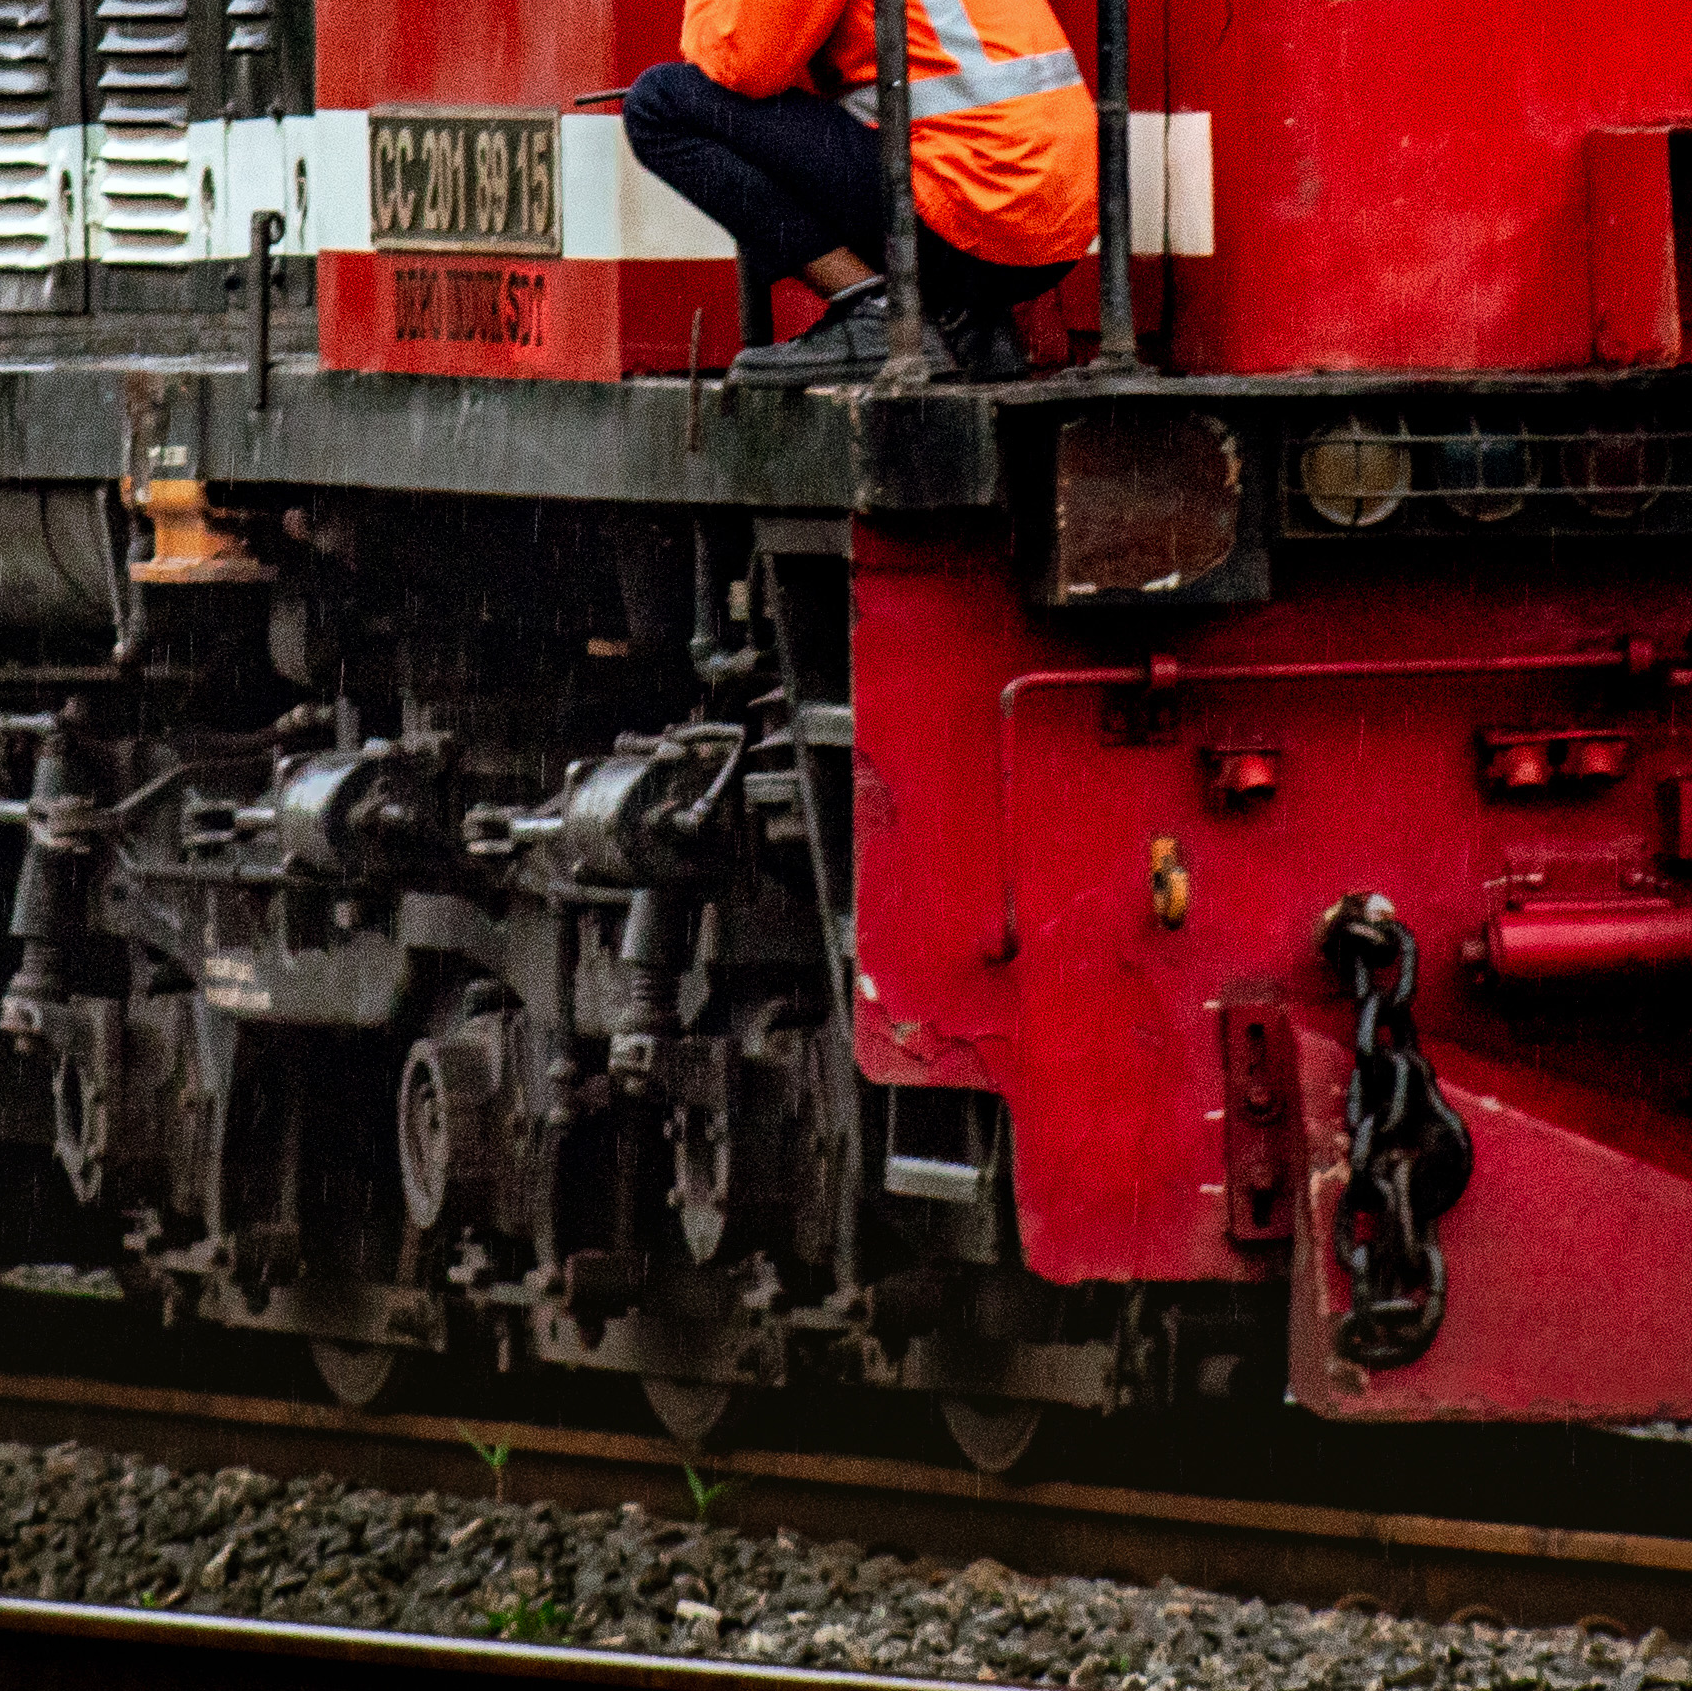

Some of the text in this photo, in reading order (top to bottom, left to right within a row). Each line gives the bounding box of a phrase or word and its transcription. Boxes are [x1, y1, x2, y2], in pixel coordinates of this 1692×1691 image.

[375, 128, 416, 231] CC
[421, 128, 466, 231] 201
[516, 130, 550, 234] 15
